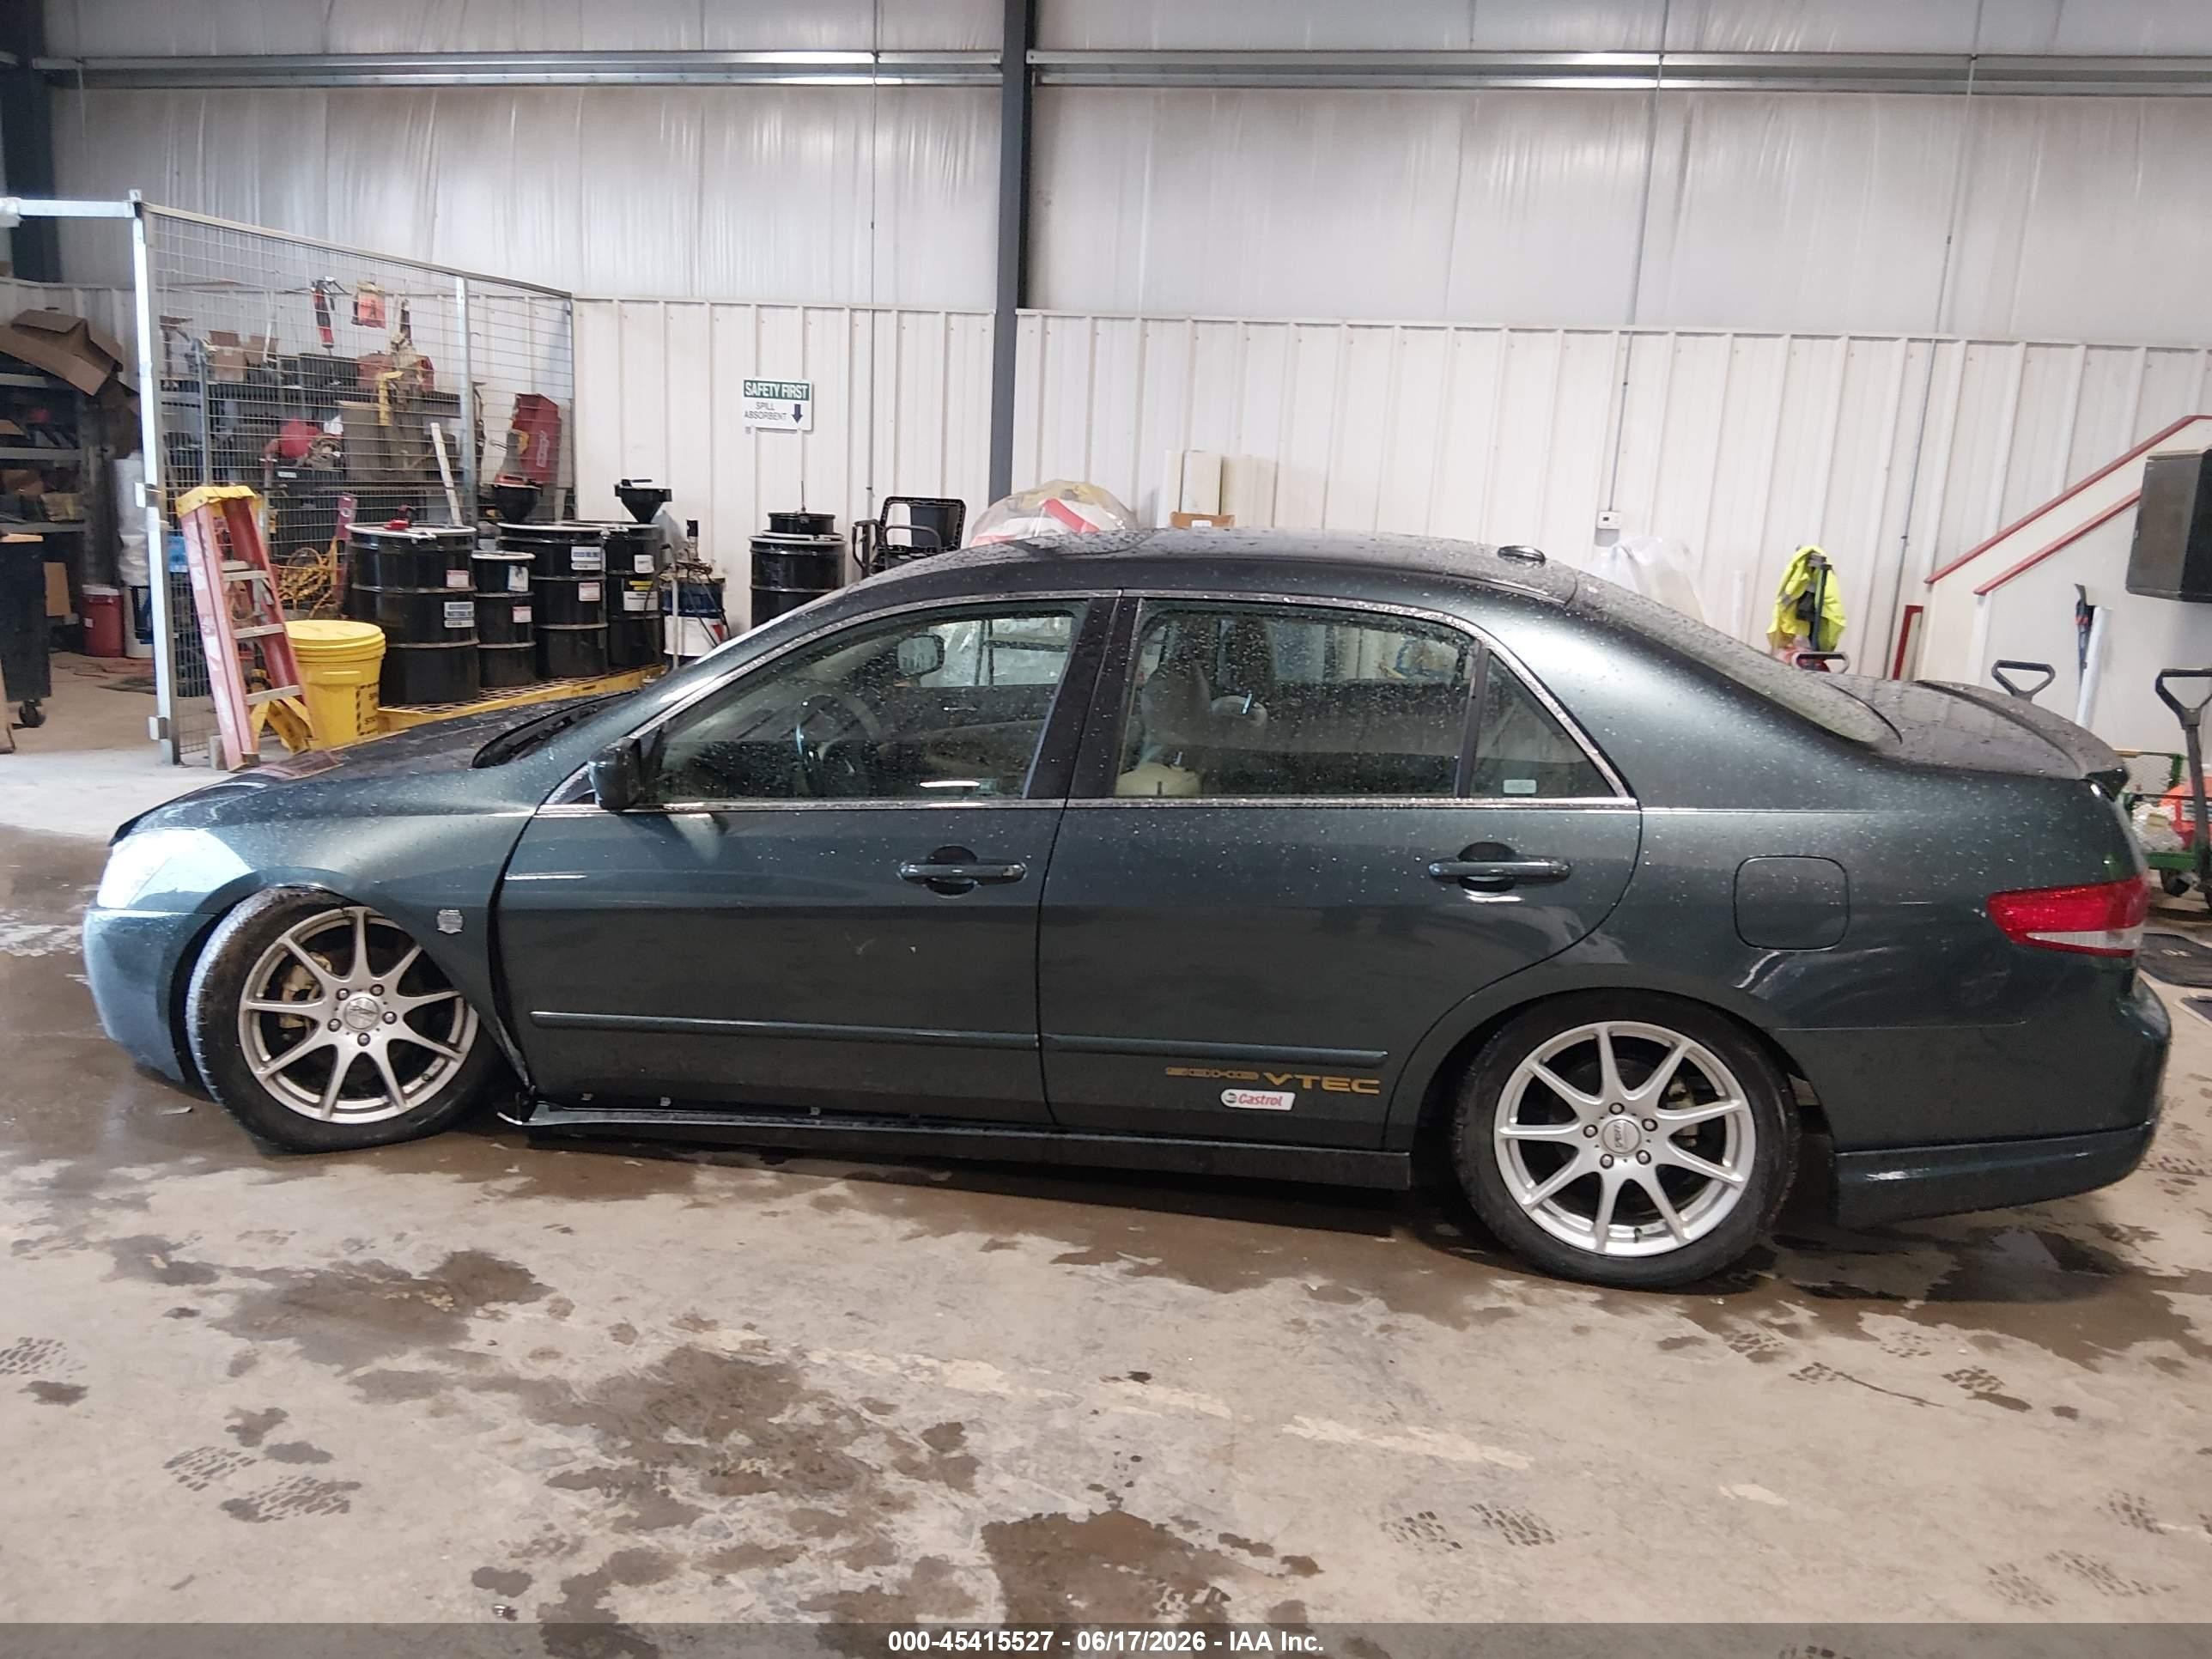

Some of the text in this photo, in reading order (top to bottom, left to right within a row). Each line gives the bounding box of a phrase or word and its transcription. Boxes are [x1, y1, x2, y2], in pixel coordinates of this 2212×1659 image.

[744, 381, 808, 399] SAFETY FIRST
[756, 401, 775, 410] SPILL
[744, 410, 787, 420] ABSORBENT
[1263, 1072, 1380, 1094] VTEC
[1238, 1092, 1283, 1107] Castrol
